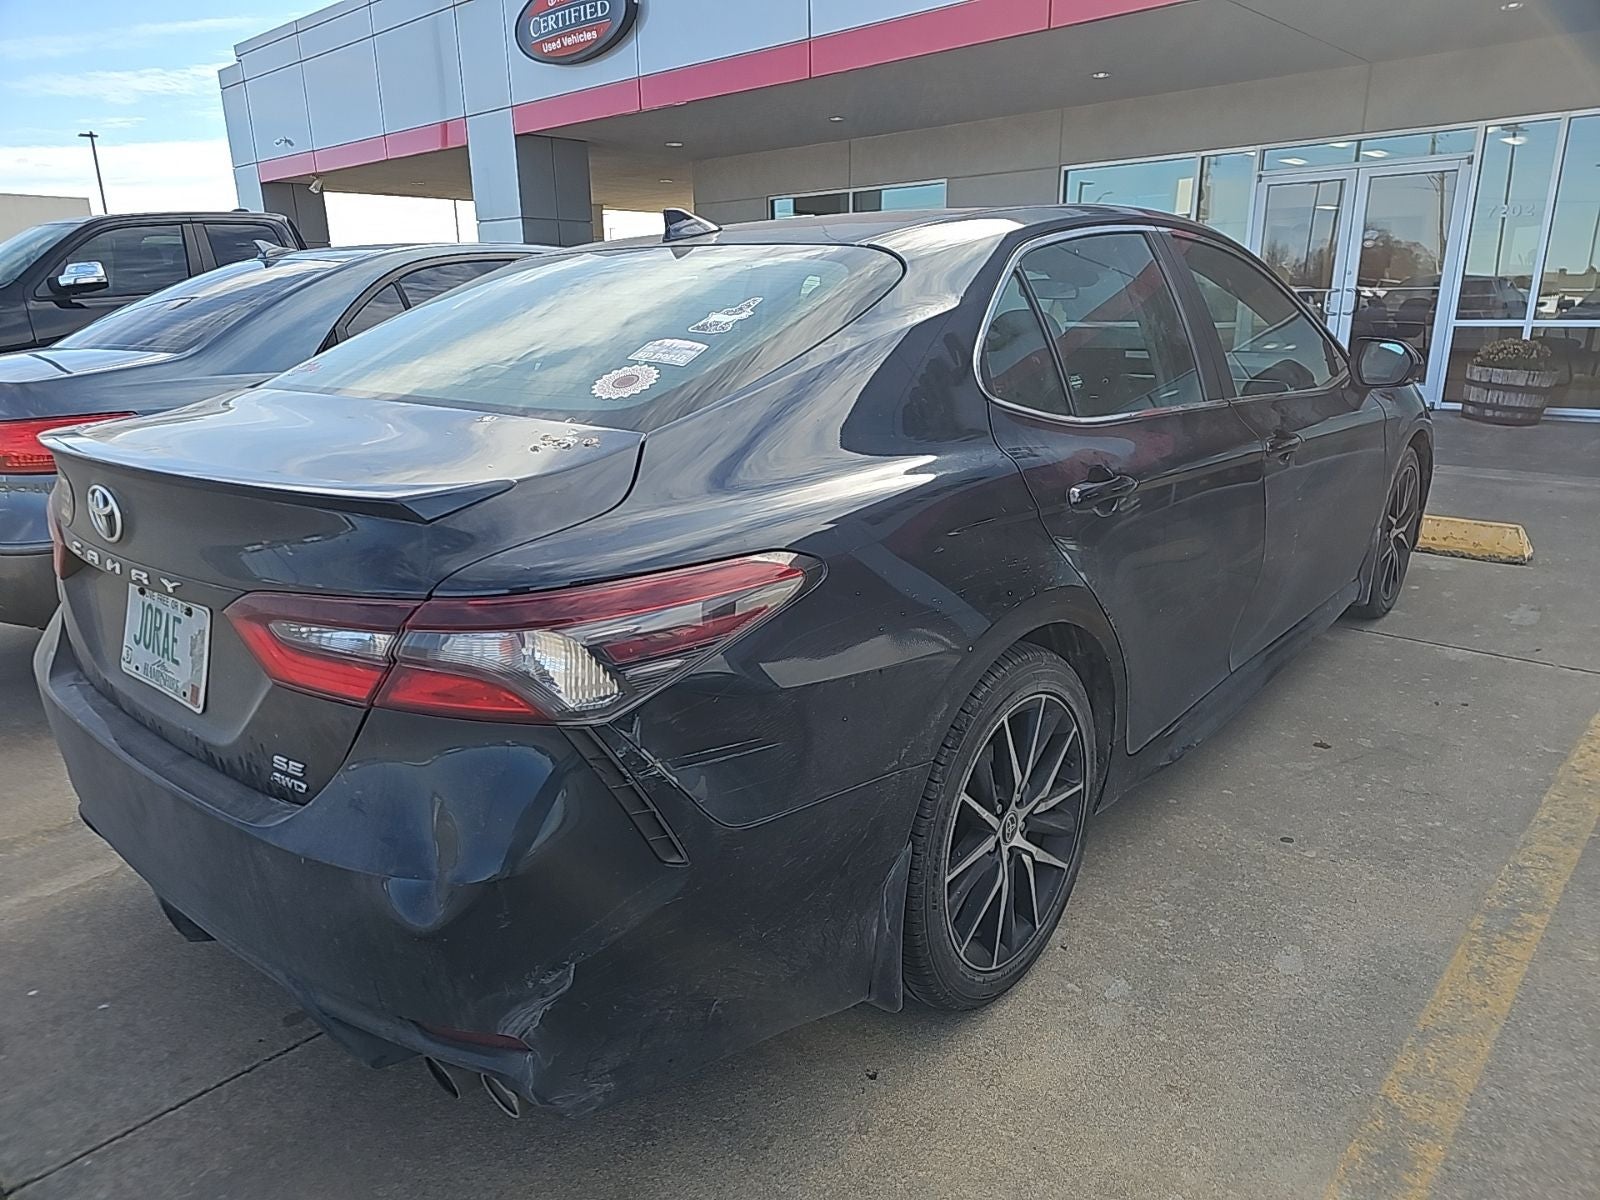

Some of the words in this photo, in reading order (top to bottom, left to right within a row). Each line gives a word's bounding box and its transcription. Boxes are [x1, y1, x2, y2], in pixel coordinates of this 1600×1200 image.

[529, 1, 610, 38] CERTIFIED
[542, 39, 562, 53] Used
[562, 29, 598, 47] Vehicles
[72, 541, 182, 593] CAMRY
[133, 601, 182, 667] JORAE
[272, 755, 305, 777] SE
[270, 771, 307, 793] AWD
